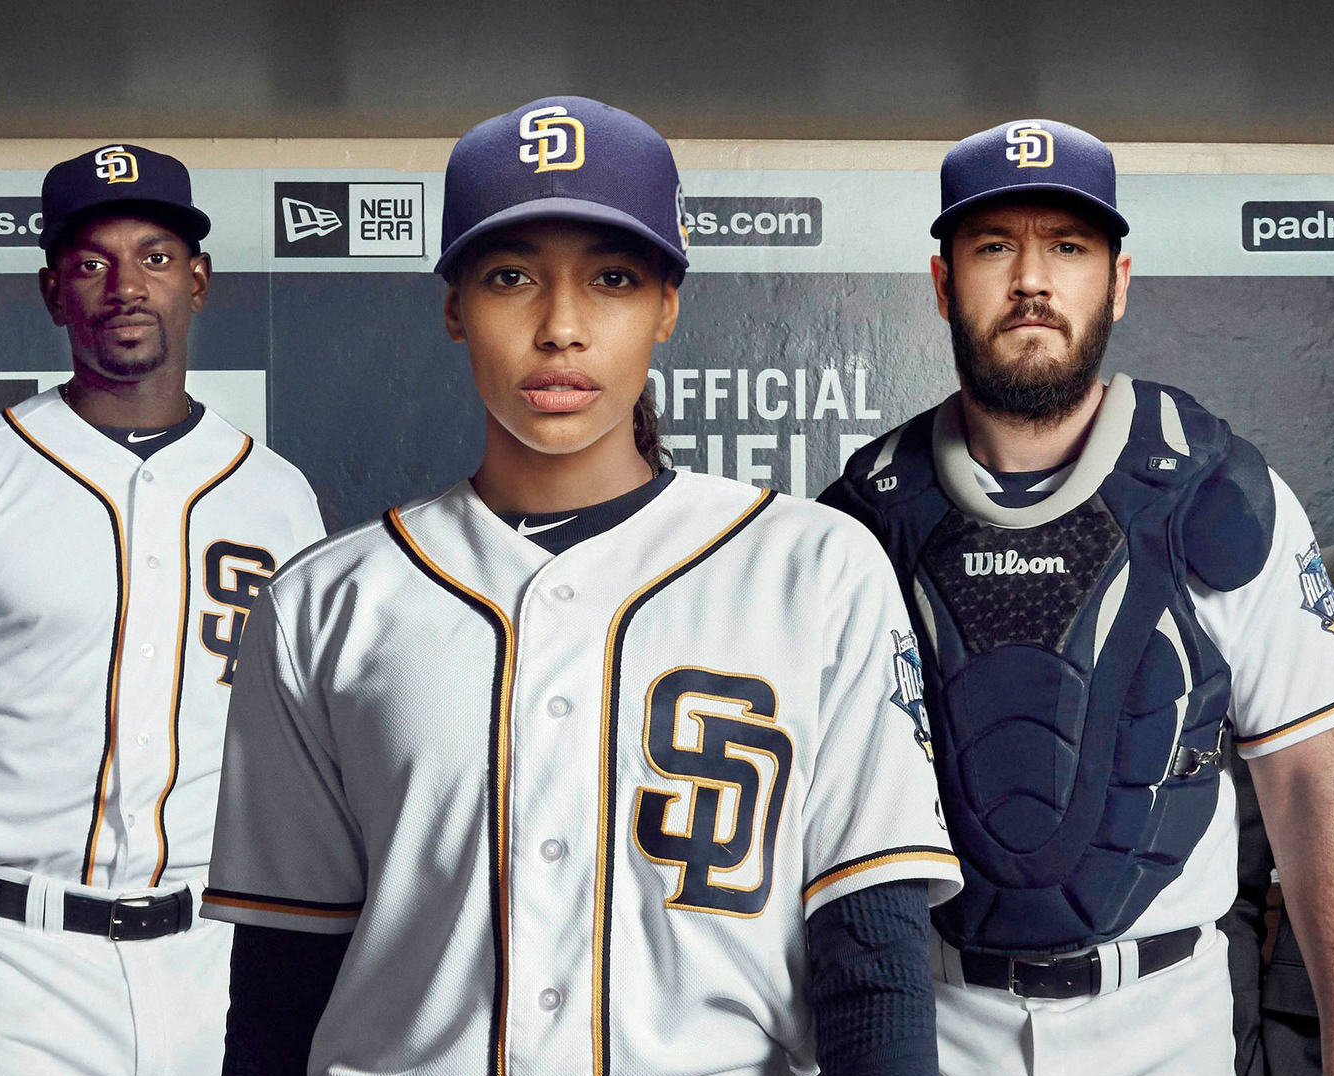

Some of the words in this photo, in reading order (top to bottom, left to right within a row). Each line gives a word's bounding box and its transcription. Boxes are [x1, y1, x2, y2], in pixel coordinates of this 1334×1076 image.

[519, 106, 585, 174] SD
[1006, 122, 1054, 168] SD
[94, 145, 139, 185] SD
[360, 199, 413, 219] NEW
[361, 221, 413, 240] ERA
[632, 665, 794, 919] SD
